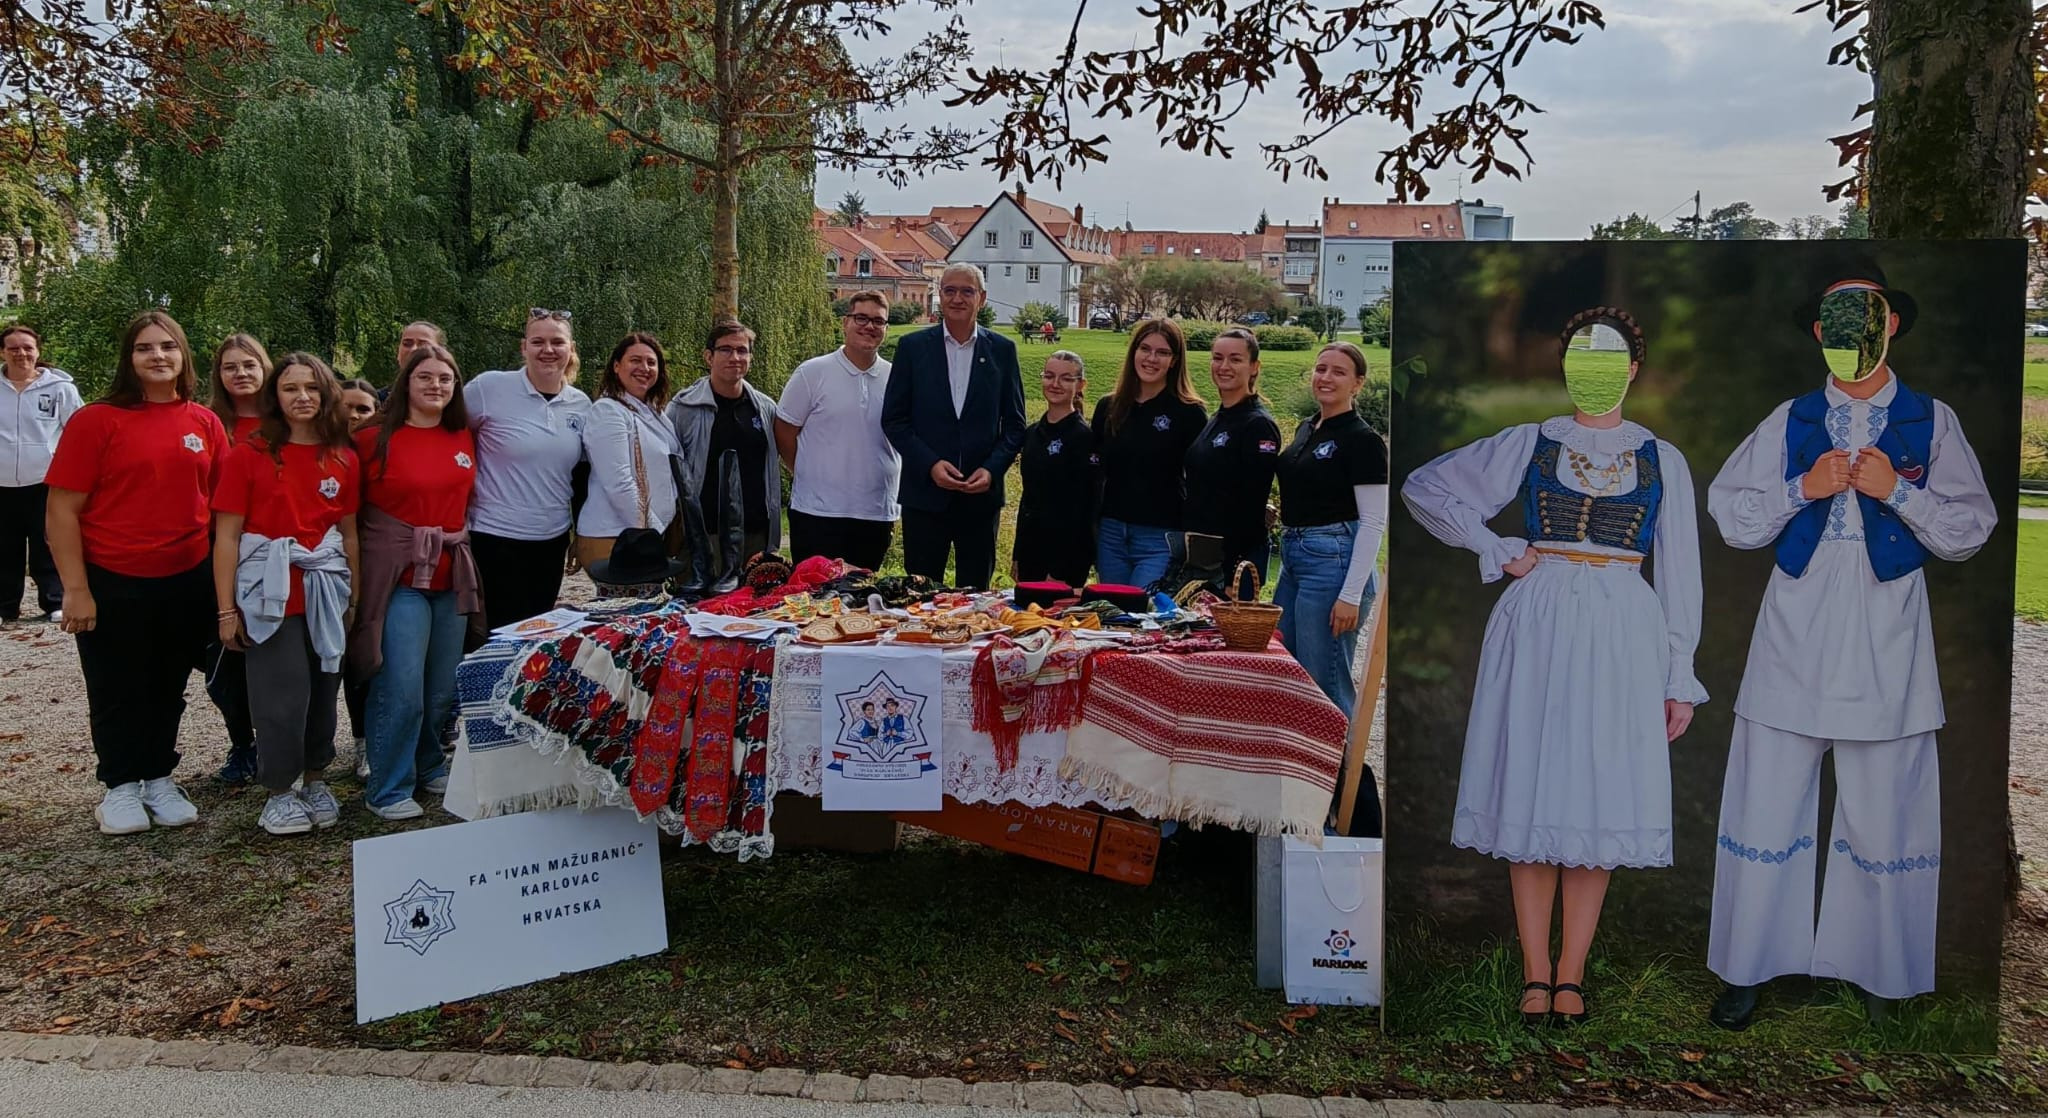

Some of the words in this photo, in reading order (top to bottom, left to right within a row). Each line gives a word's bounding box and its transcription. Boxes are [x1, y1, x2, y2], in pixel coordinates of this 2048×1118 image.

[469, 873, 487, 886] FA
[521, 871, 600, 897] KARLOVAC
[523, 898, 602, 925] HRVATSKA
[1312, 957, 1368, 969] KARLOVAC
